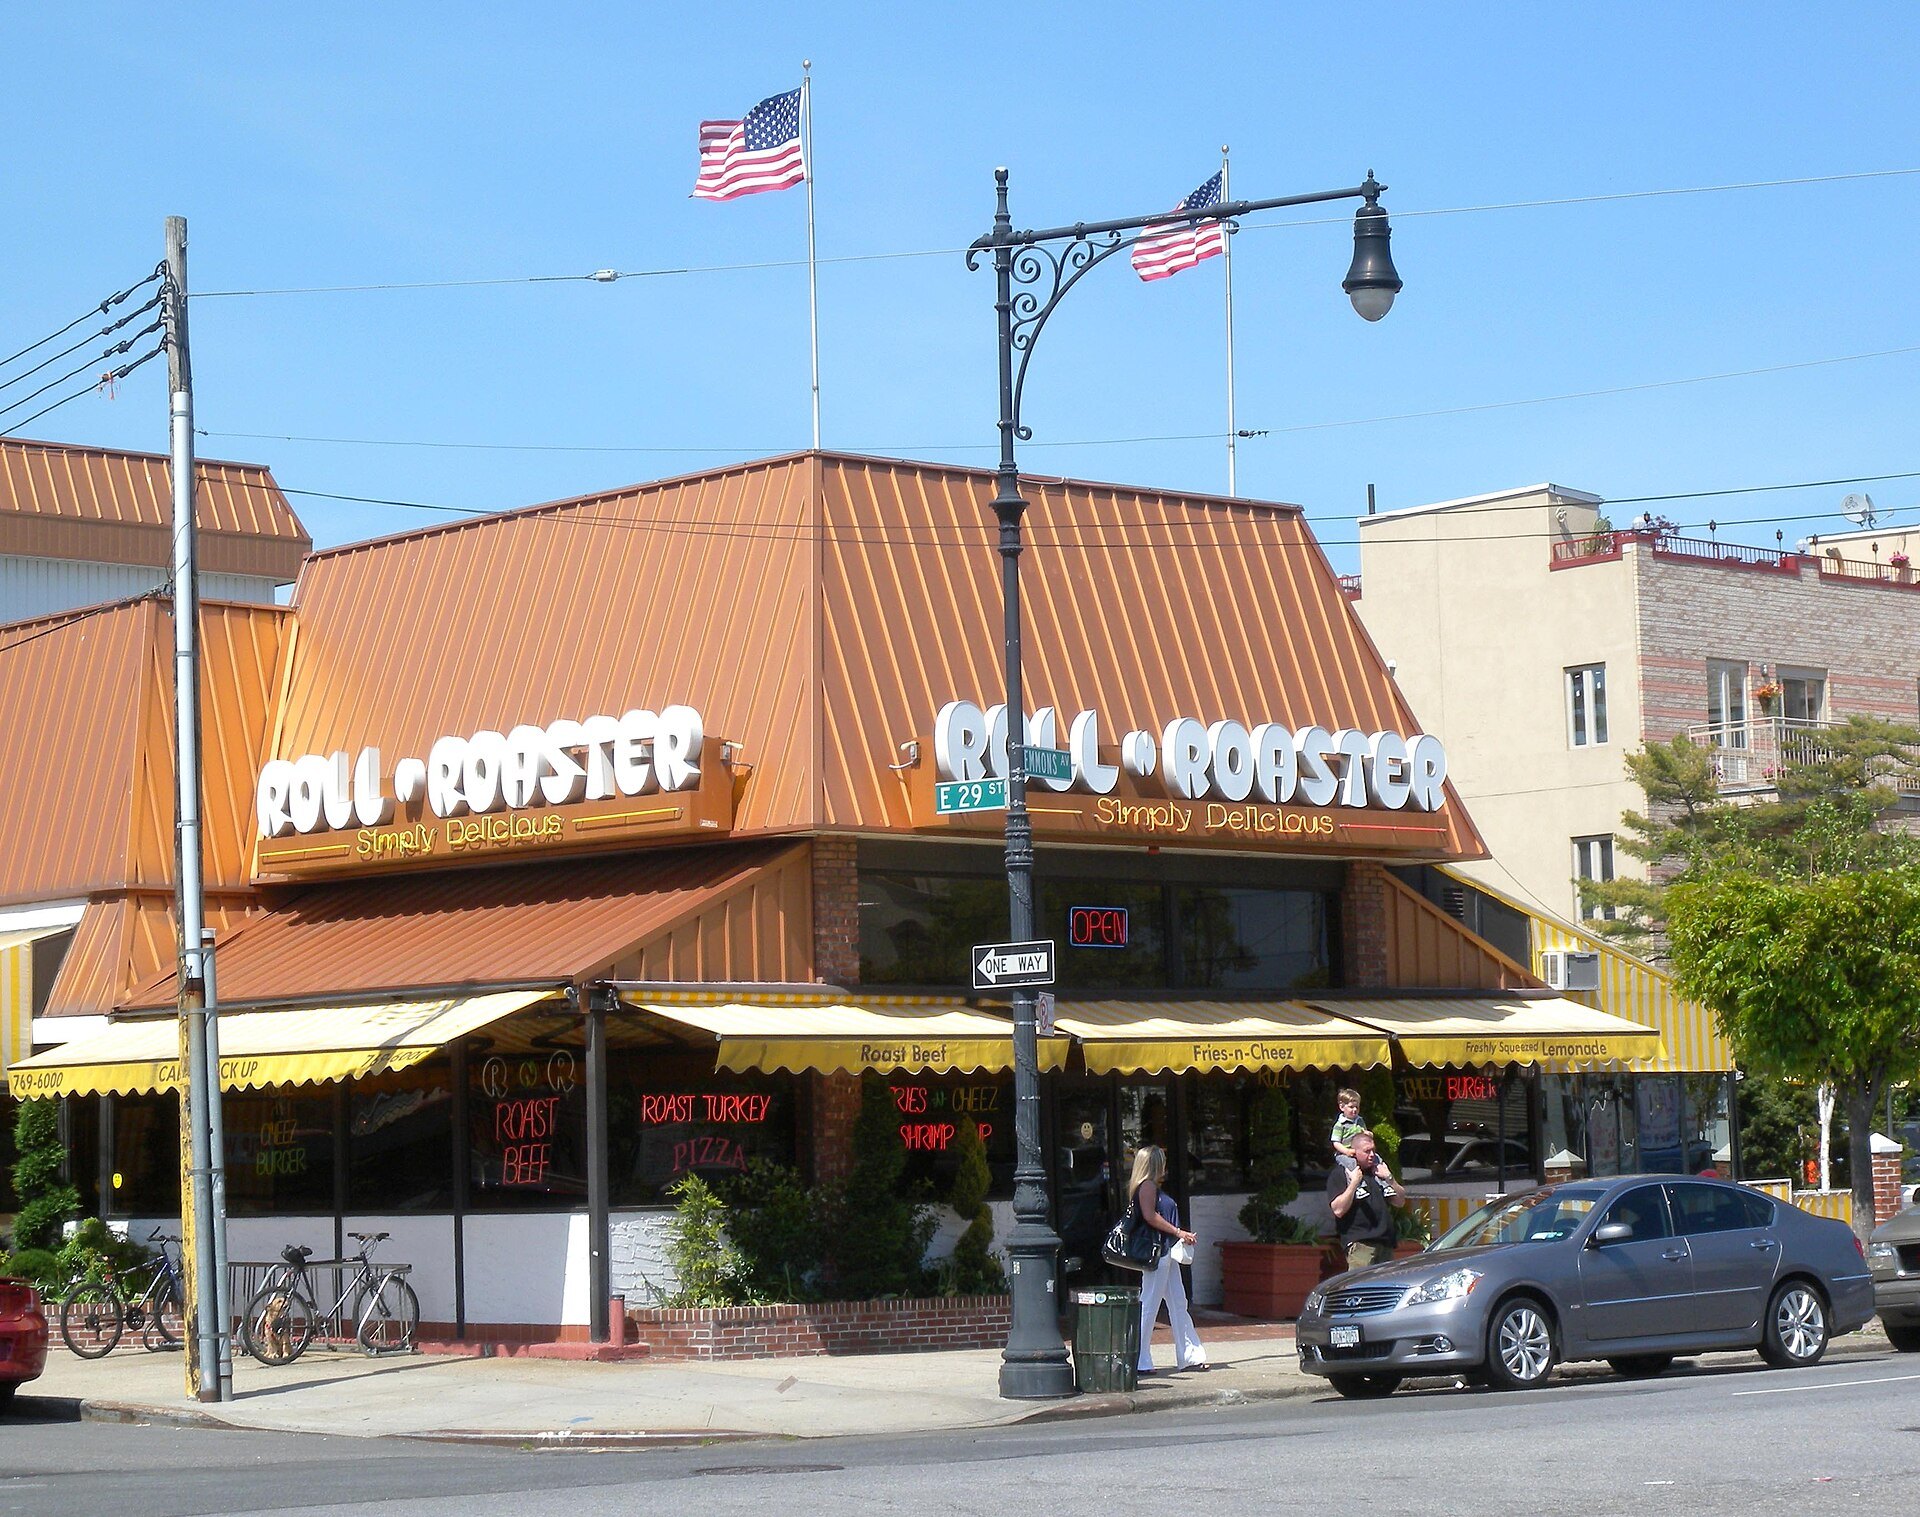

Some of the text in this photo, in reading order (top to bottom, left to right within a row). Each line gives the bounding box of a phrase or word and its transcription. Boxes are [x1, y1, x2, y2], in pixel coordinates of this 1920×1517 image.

[257, 746, 391, 837] ROLL
[427, 704, 703, 818] ROASTER
[1024, 750, 1057, 775] EMMONS
[1162, 717, 1447, 811] ROASTER
[940, 782, 1003, 809] E 29 ST
[1094, 798, 1333, 834] Simply Delicious
[357, 813, 564, 853] Simply Delicious
[1073, 910, 1125, 943] OPEN
[985, 955, 1042, 974] ONE WAY
[861, 1044, 947, 1062] Roast Beef
[1193, 1043, 1294, 1061] Fries-n-Cheez
[1465, 1039, 1607, 1057] Freshly Squeezed Lemonade
[13, 1071, 63, 1090] 769-6000
[241, 1061, 258, 1078] UP
[642, 1094, 771, 1123] ROAST TURKEY
[952, 1086, 998, 1113] CHEEZ
[496, 1098, 559, 1140] ROAST
[900, 1123, 955, 1150] SHRIMP
[503, 1144, 551, 1185] BEEF
[672, 1137, 748, 1173] PIZZA
